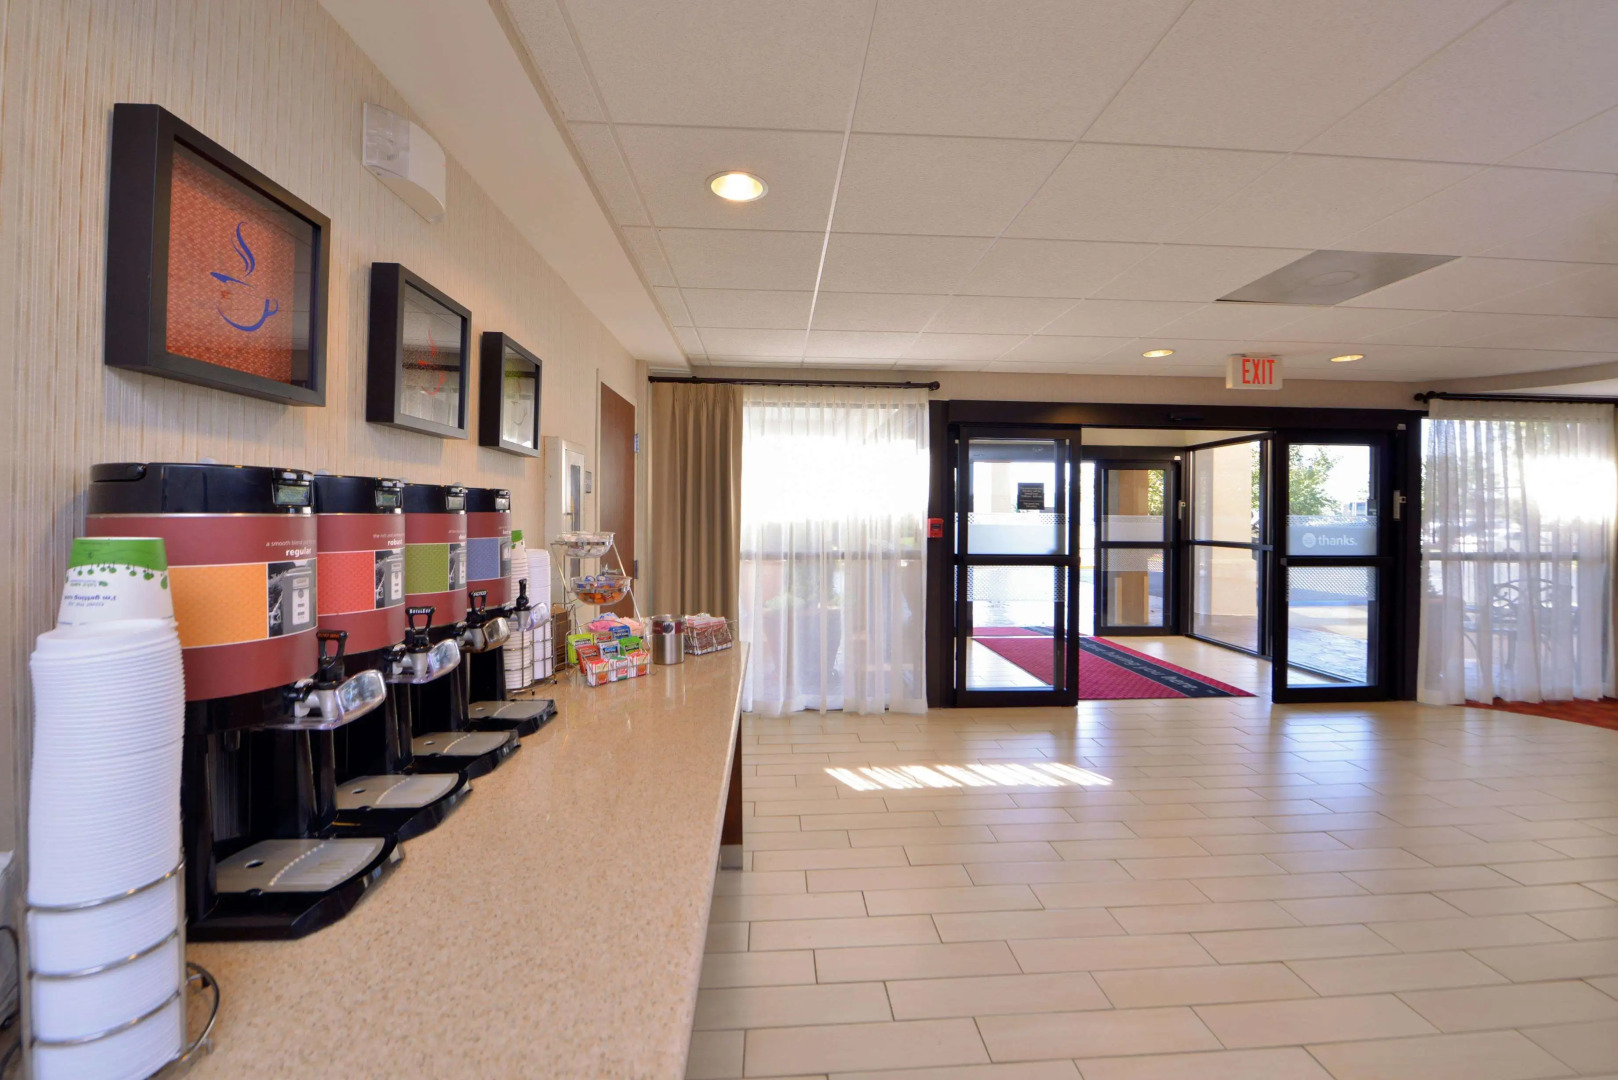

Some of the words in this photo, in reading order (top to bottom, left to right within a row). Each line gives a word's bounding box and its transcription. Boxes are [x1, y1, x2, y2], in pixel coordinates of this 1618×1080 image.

[1242, 358, 1276, 385] EXIT
[286, 547, 312, 558] regular
[1133, 665, 1166, 676] you
[1160, 675, 1199, 692] here.
